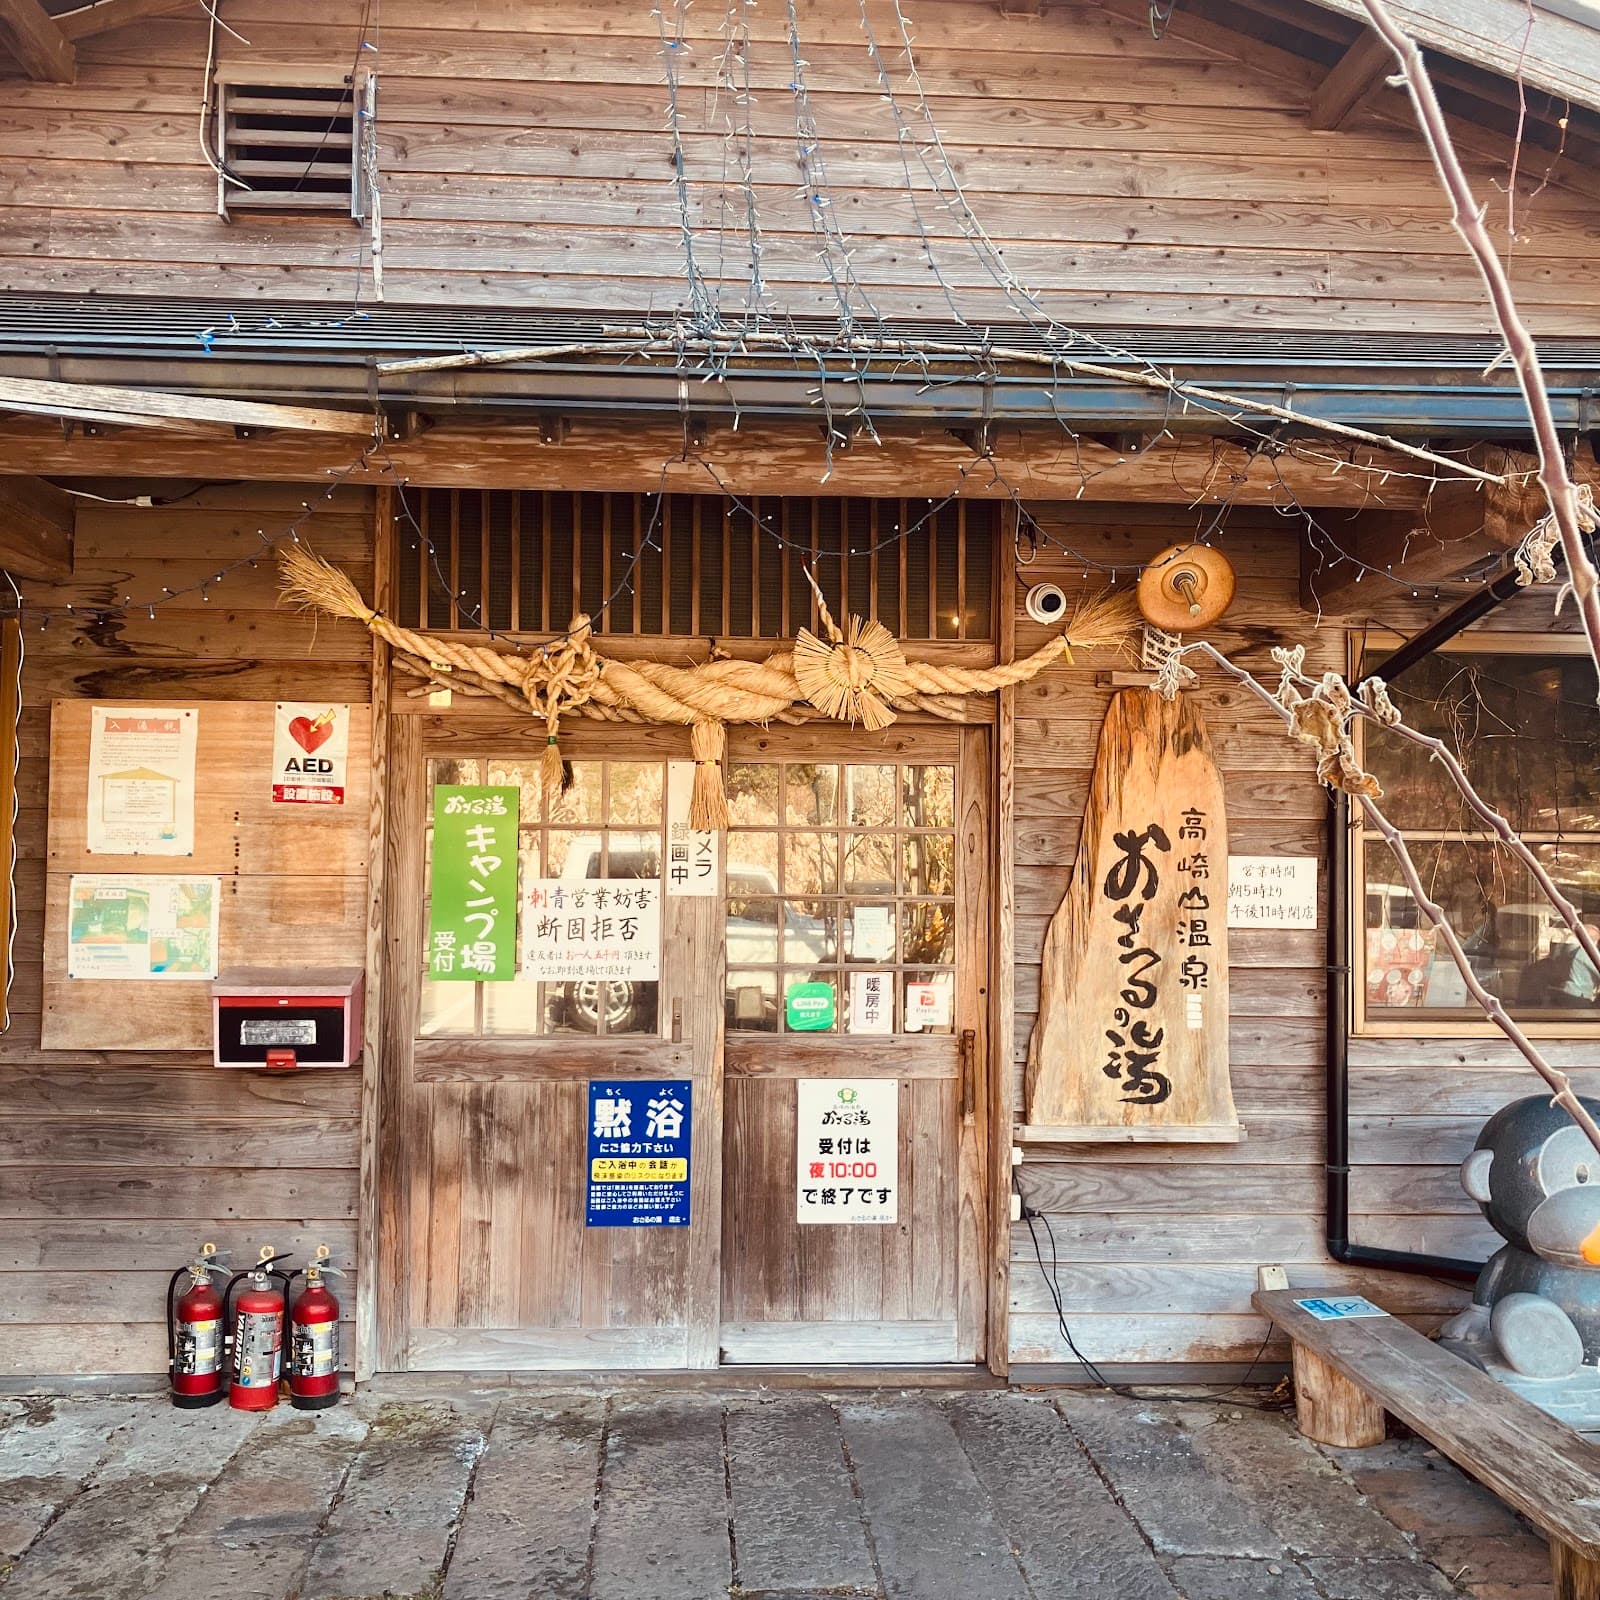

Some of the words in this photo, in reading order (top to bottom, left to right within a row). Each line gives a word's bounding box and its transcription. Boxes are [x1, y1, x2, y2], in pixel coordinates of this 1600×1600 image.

[284, 757, 334, 773] AED
[671, 821, 690, 886] 録画中
[695, 829, 713, 878] メラ
[1242, 864, 1296, 879] 営業時間
[460, 823, 503, 974] キャンプ場
[530, 886, 652, 910] 刺青営業妨害
[1228, 882, 1283, 899] 朝5時より
[1230, 903, 1315, 920] 午後11時閉店
[537, 915, 639, 944] 断固拒否
[433, 930, 457, 972] 受付
[865, 977, 881, 1025] 暖房中
[605, 1088, 622, 1096] もく
[658, 1088, 674, 1096] よく
[593, 1098, 685, 1139] 黙浴
[599, 1143, 674, 1153] にご協力下さい
[818, 1137, 871, 1155] 受付は
[809, 1161, 877, 1179] 夜10:00
[802, 1187, 892, 1205] で終了です
[234, 1313, 246, 1370] YAMATO
